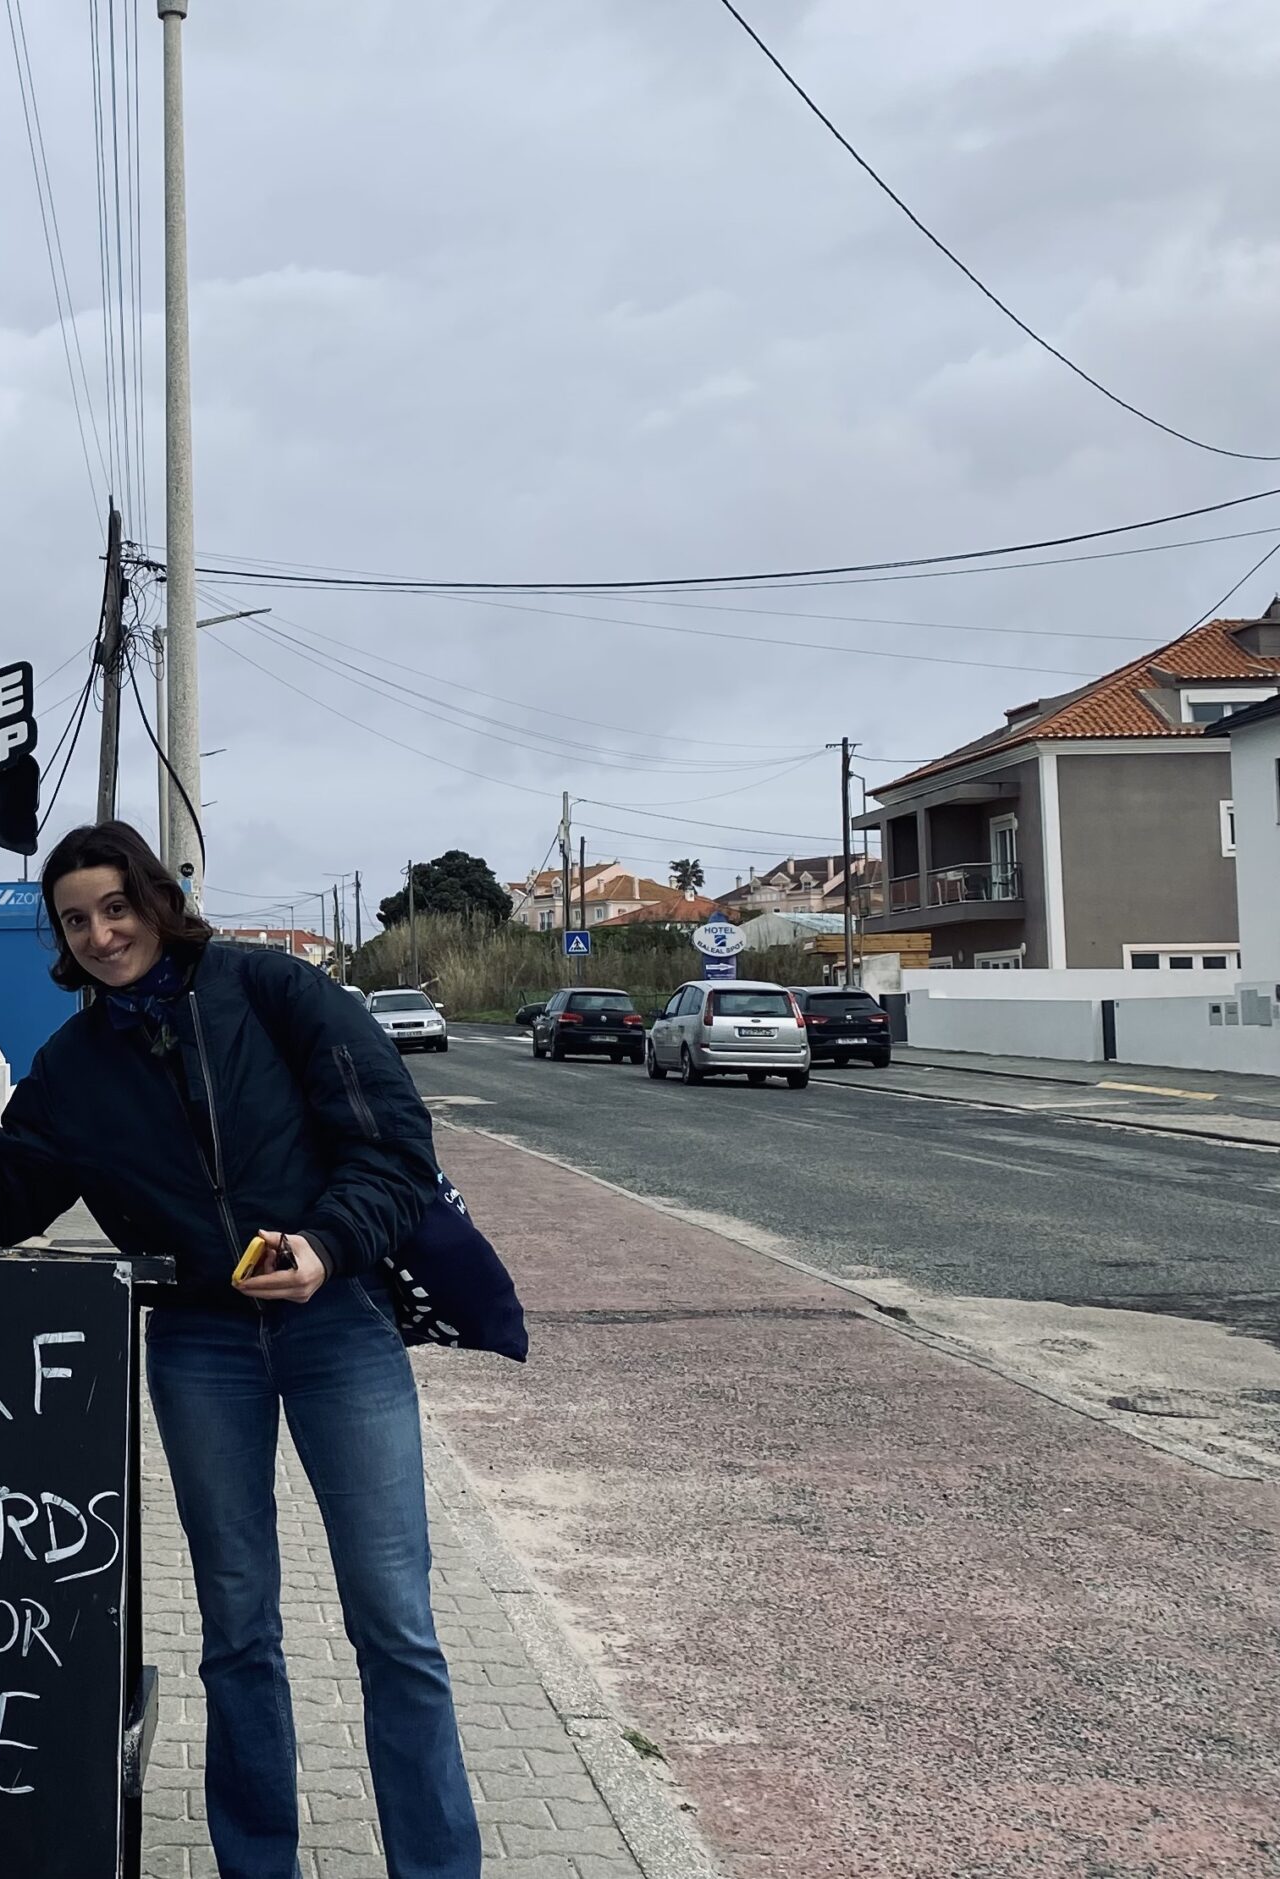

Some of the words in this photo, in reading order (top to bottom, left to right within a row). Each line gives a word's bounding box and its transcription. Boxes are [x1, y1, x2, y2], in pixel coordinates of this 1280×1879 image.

[704, 926, 736, 934] HOTEL
[697, 940, 725, 954] BALEAL
[726, 940, 744, 953] SPOT
